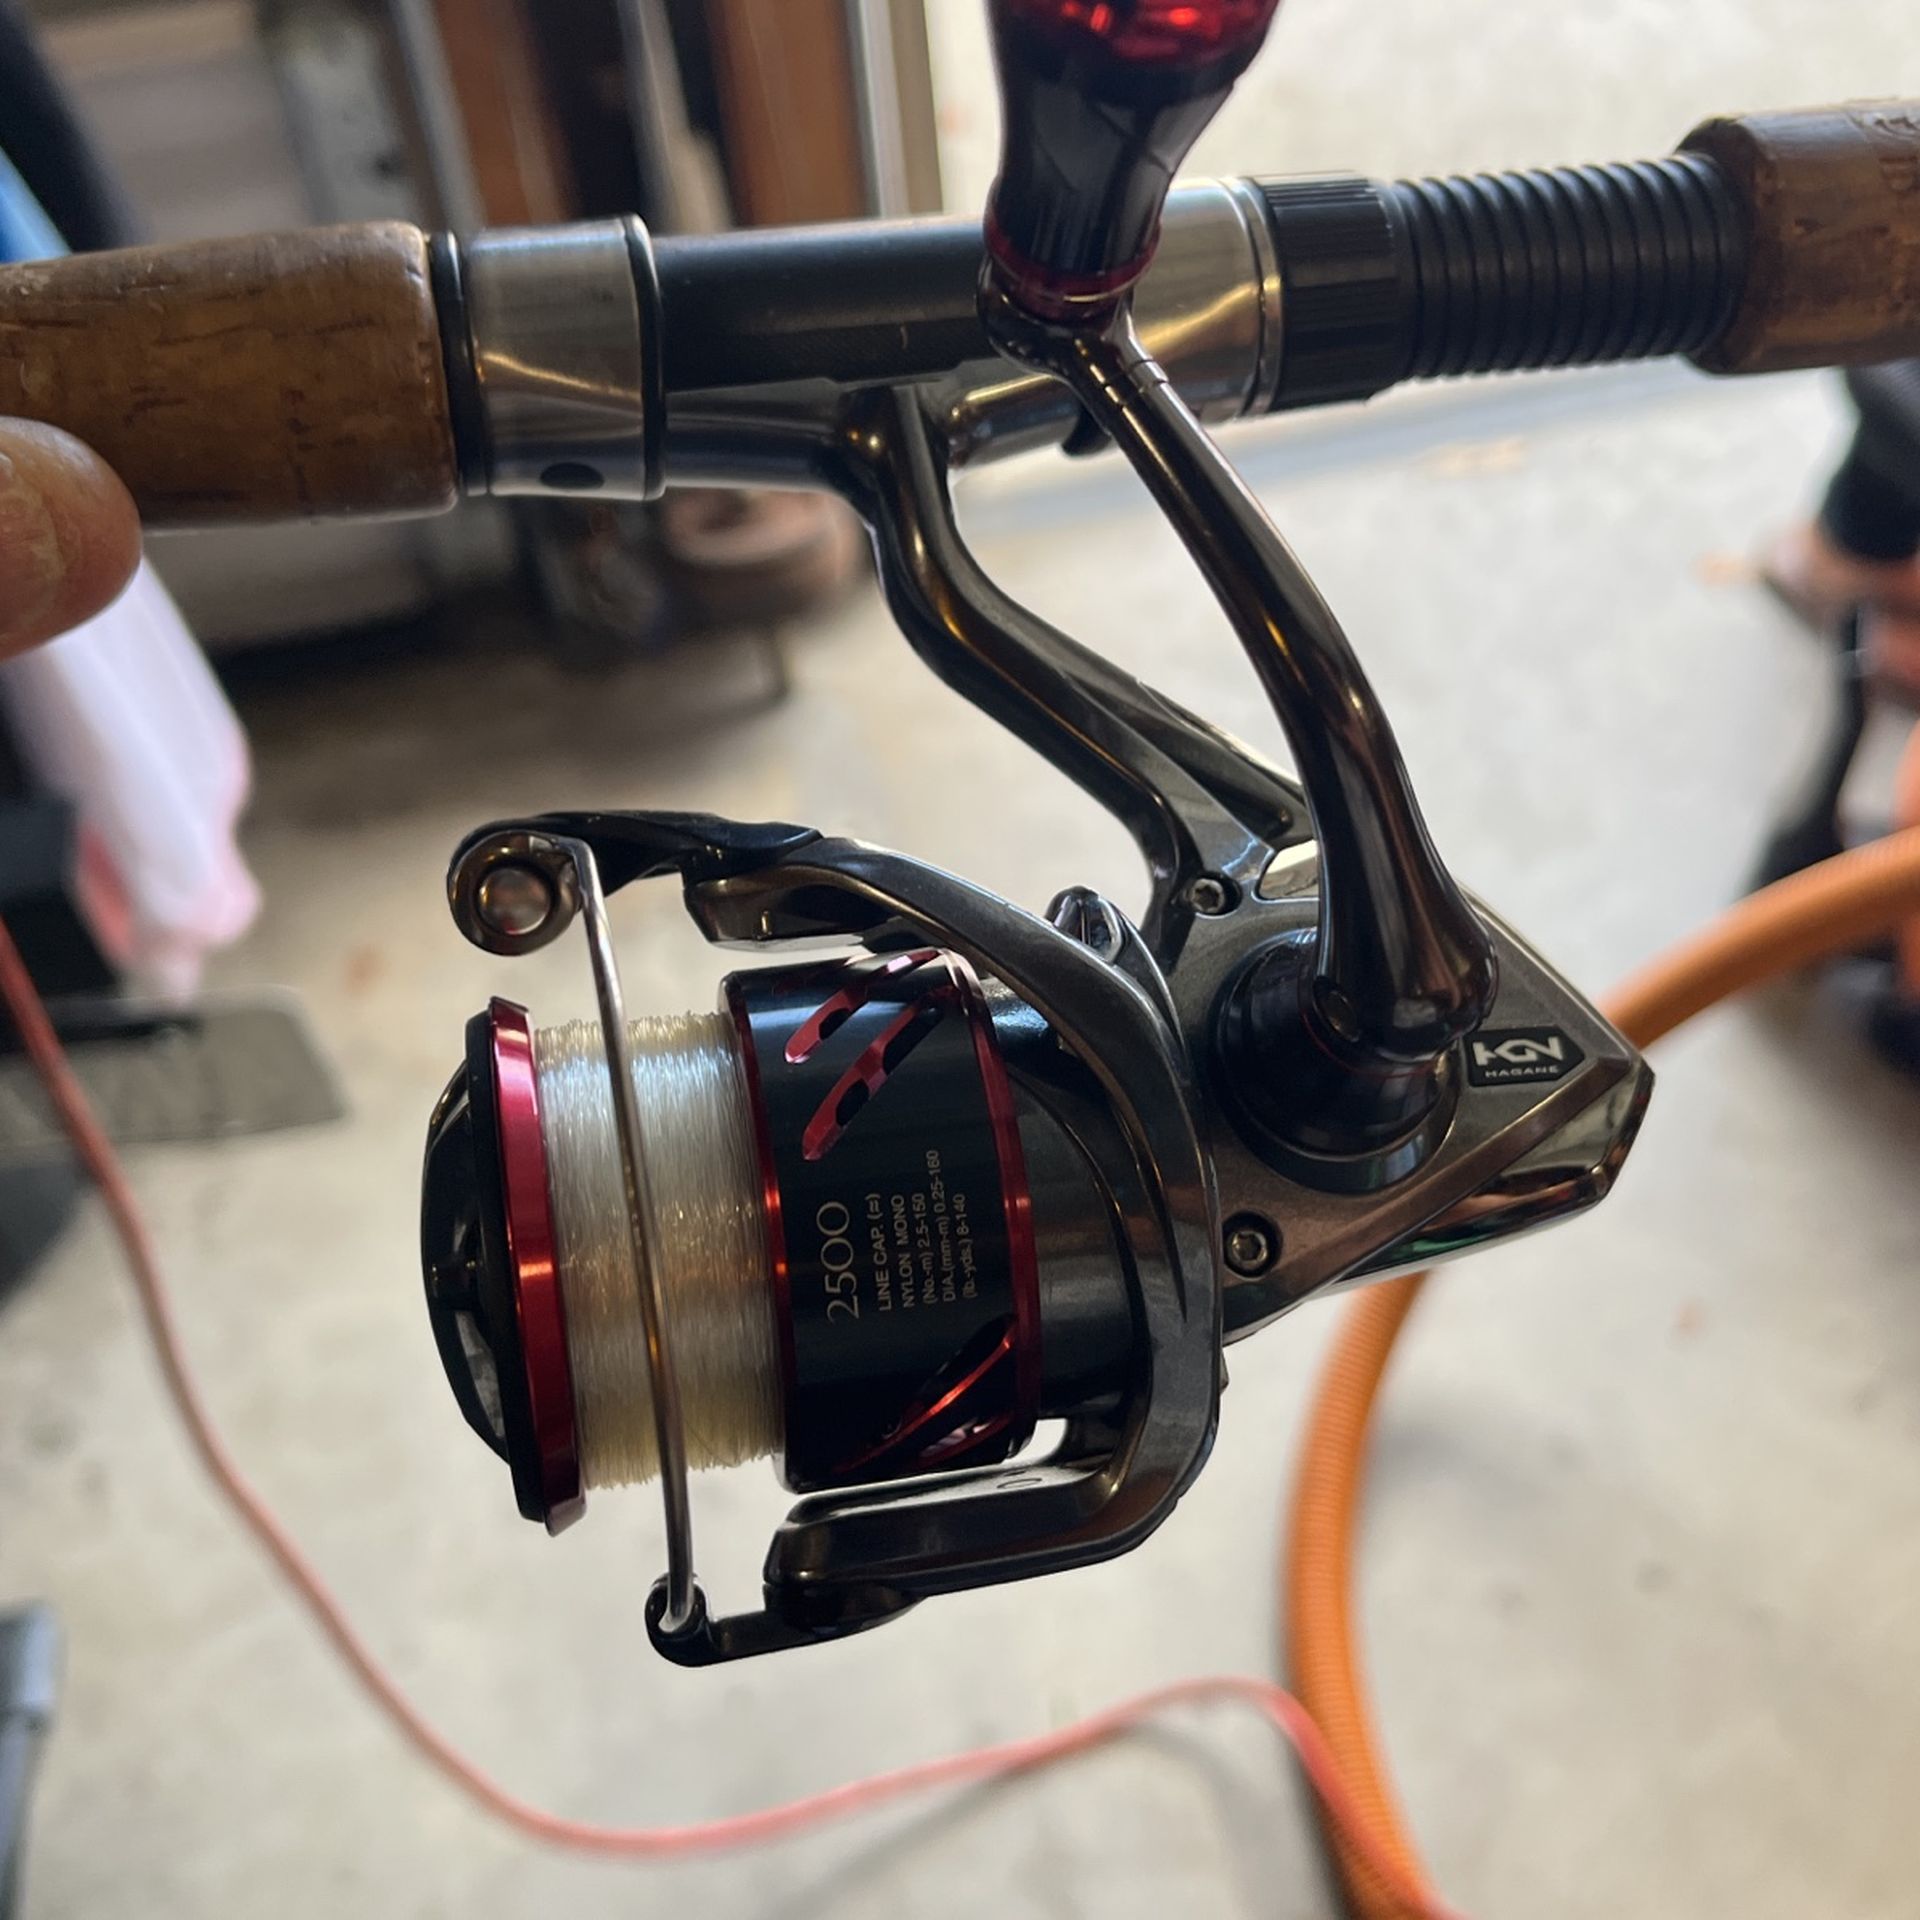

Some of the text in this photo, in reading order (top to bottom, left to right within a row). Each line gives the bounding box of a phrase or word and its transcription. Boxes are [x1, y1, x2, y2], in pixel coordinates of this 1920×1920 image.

[1485, 1065, 1559, 1078] HAGANE
[927, 1150, 946, 1214] 0.25-160
[913, 1193, 930, 1247] 2.5-150
[954, 1194, 969, 1236] 8-140
[816, 1201, 860, 1324] 2500
[871, 1224, 887, 1265] CAP.
[891, 1195, 915, 1308] NYLON MONO
[876, 1268, 892, 1311] LINE
